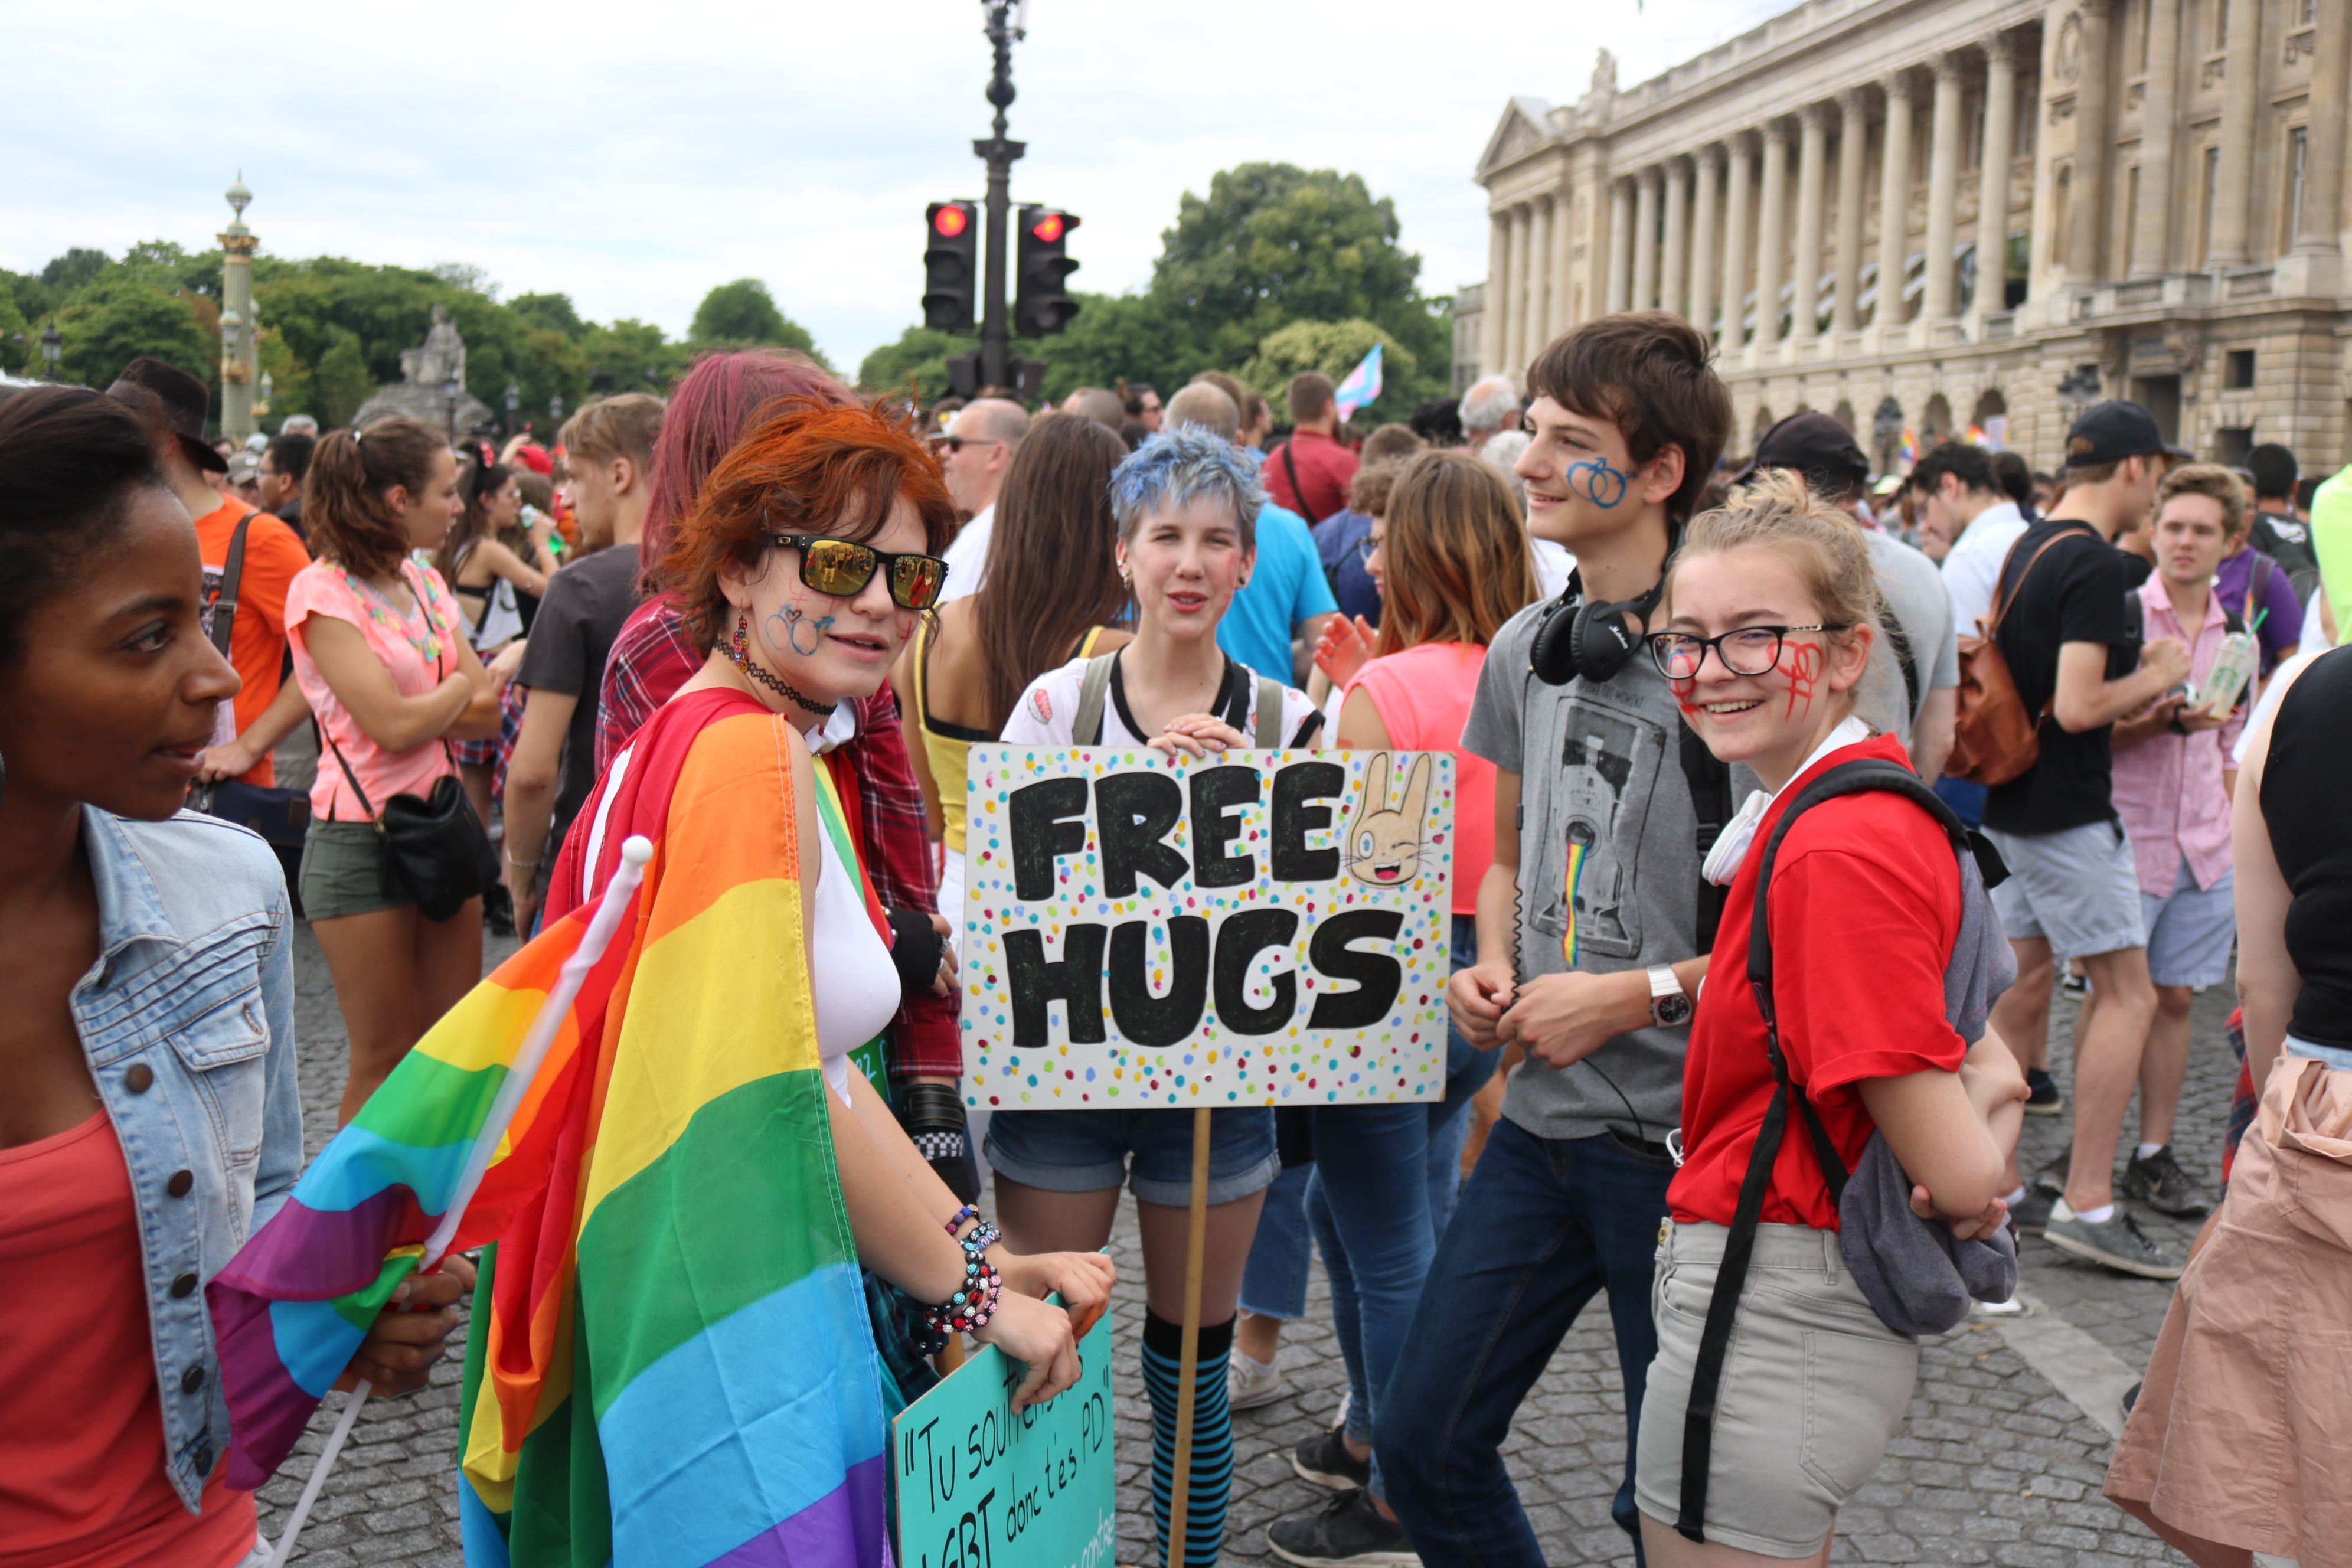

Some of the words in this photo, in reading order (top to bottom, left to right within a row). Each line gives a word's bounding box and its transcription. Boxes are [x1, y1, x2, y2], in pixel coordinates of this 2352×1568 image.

[1616, 689, 1644, 708] MOMENT
[1010, 761, 1345, 902] FREE
[1002, 908, 1404, 1048] HUGS
[922, 1487, 995, 1568] GBT
[1007, 1472, 1041, 1543] donc
